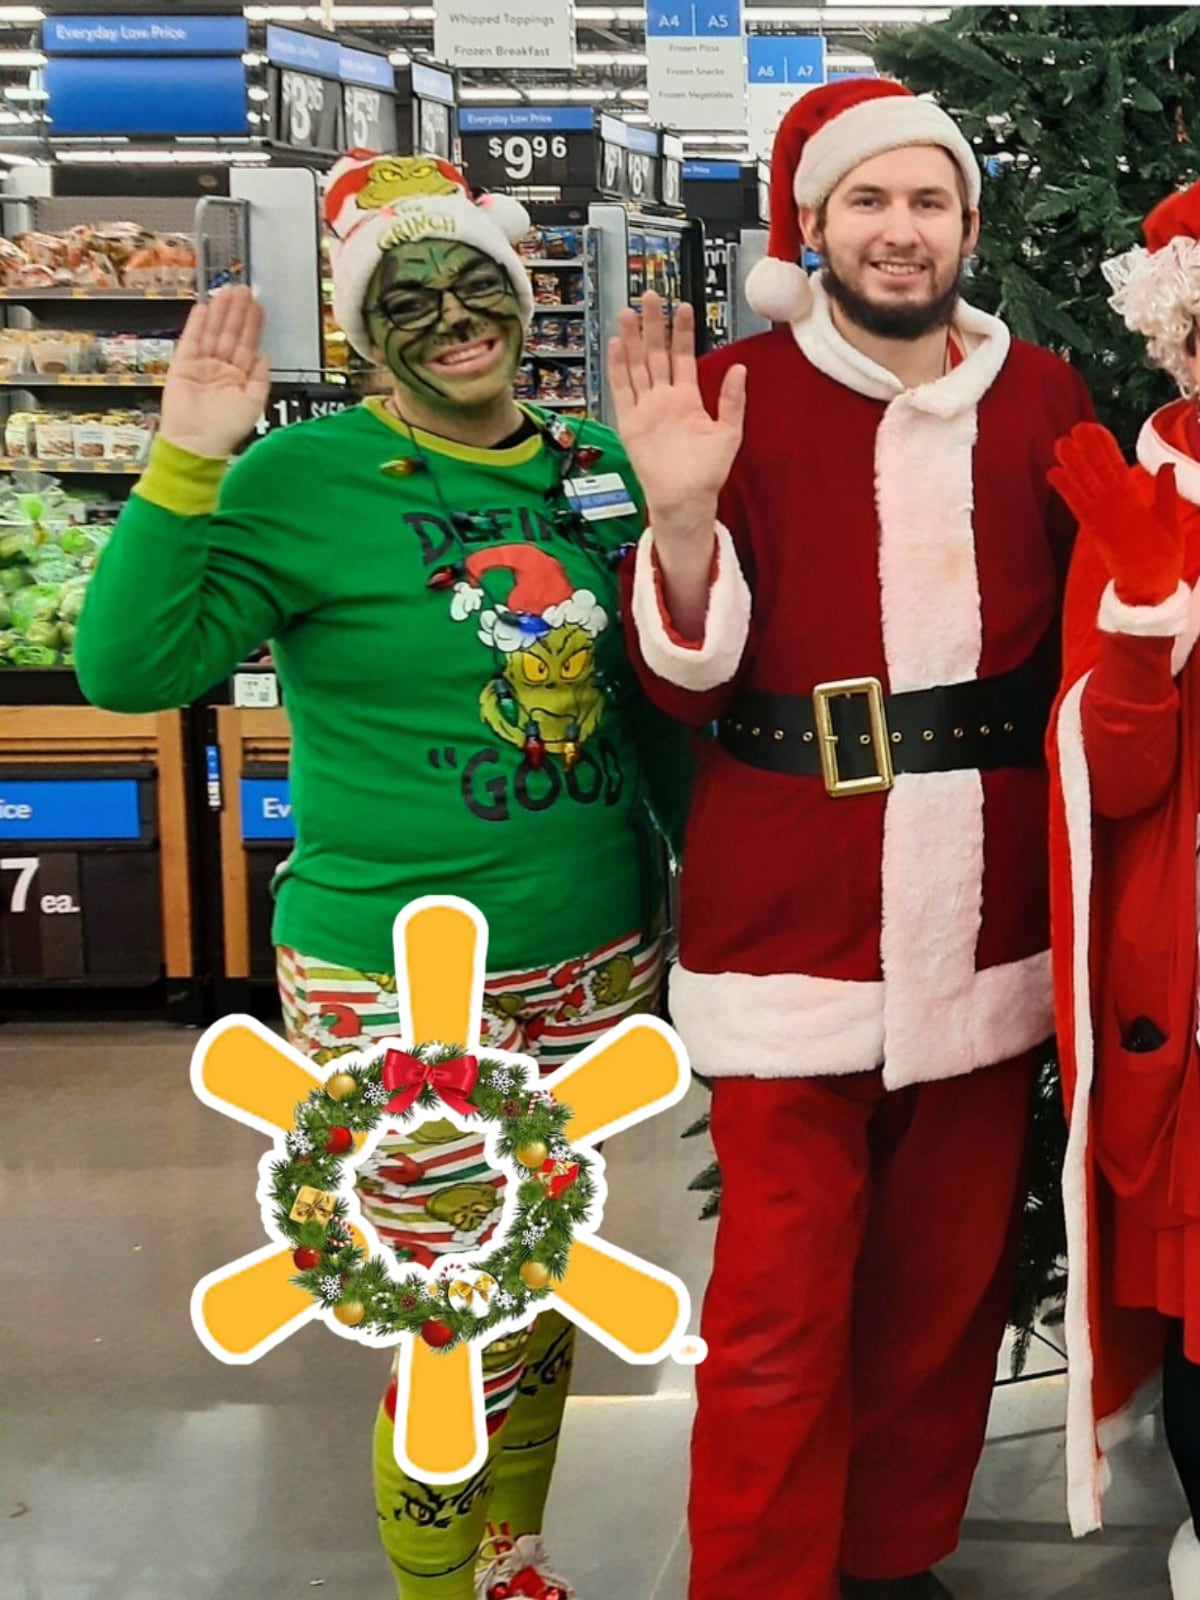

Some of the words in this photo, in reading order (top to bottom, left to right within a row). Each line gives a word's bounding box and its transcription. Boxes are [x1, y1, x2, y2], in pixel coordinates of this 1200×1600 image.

[450, 13, 500, 26] Whipped
[504, 13, 555, 27] Toppings
[659, 15, 679, 28] A4
[708, 15, 729, 28] A5
[55, 24, 119, 42] Everyday
[120, 25, 149, 39] Low
[151, 25, 186, 39] Price
[454, 46, 493, 57] Frozen
[496, 46, 551, 57] Breakfast
[668, 44, 697, 52] Frozen
[666, 67, 694, 75] Frozen
[757, 65, 775, 77] A6
[797, 65, 814, 77] A7
[467, 114, 508, 125] Everyday
[509, 115, 528, 124] Low
[530, 114, 553, 124] Price
[376, 214, 457, 252] GRINCH
